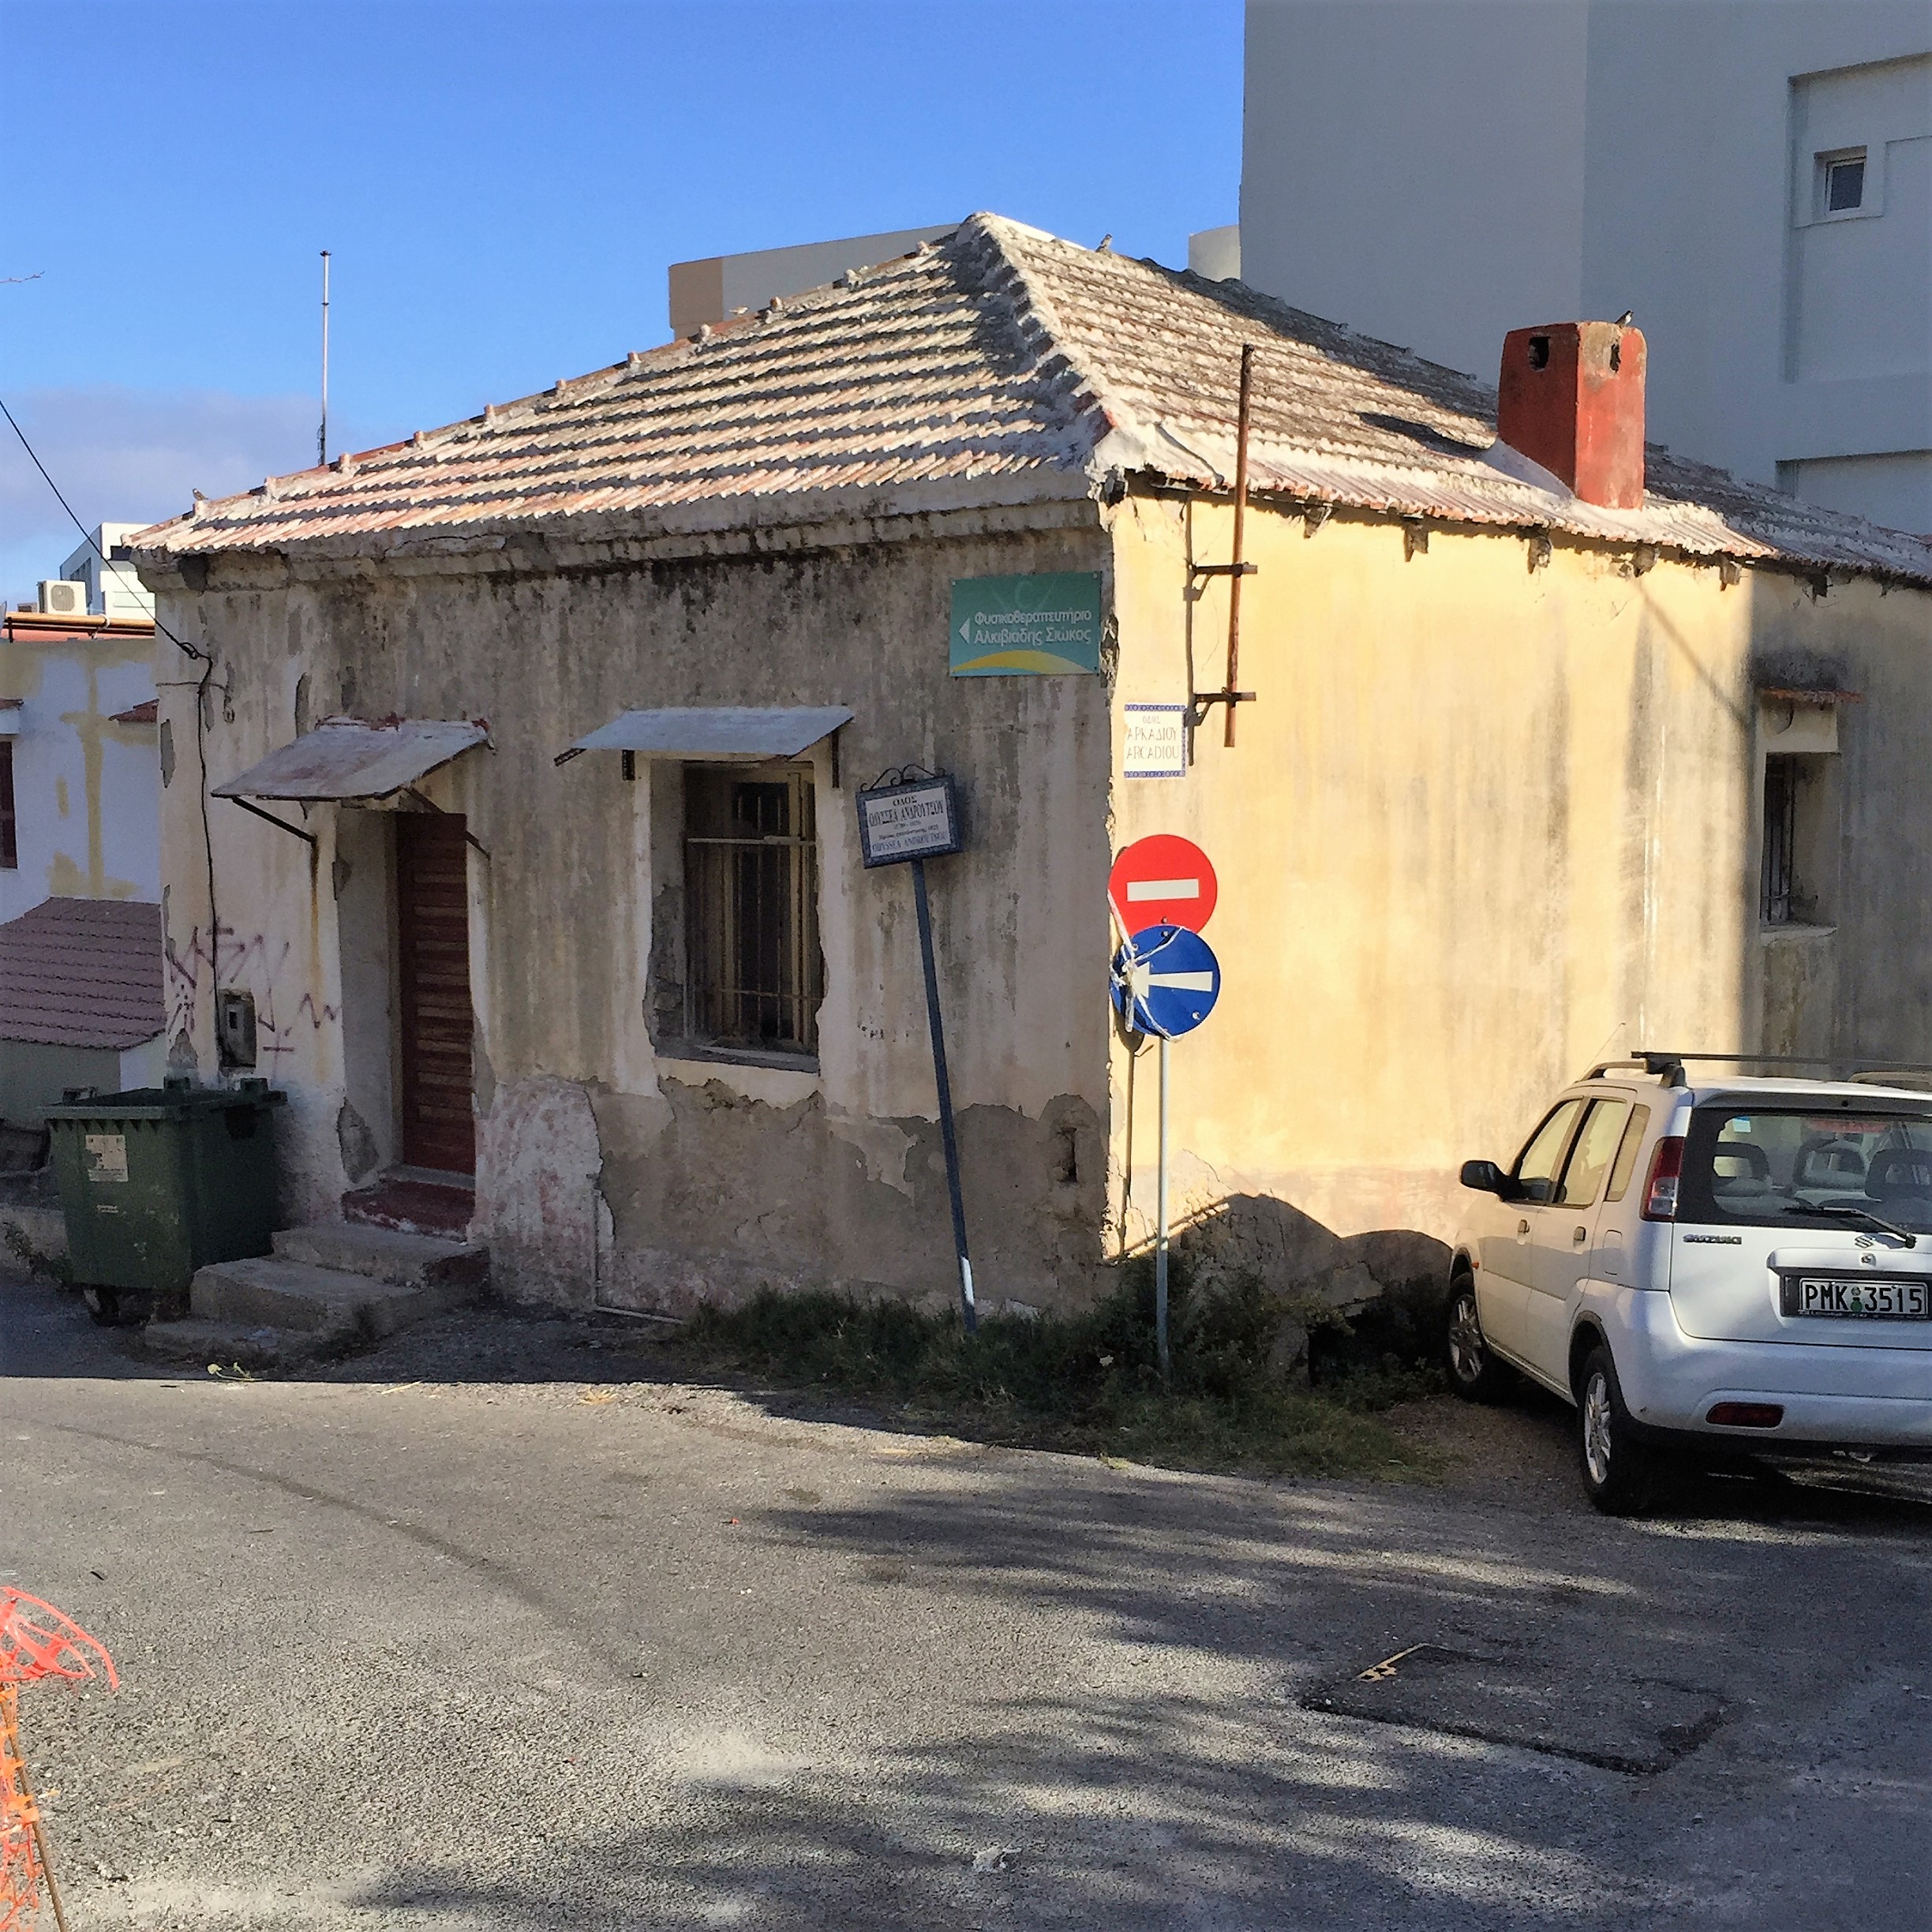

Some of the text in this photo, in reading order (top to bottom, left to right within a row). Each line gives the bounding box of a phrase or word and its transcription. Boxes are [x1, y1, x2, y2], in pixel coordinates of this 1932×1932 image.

[1127, 726, 1179, 741] ΑΡΚΑΔΙΟΥ
[1126, 745, 1180, 759] ARCADIOU
[1682, 1234, 1743, 1245] SUZUKI
[1805, 1284, 1923, 1313] PMK 3515
